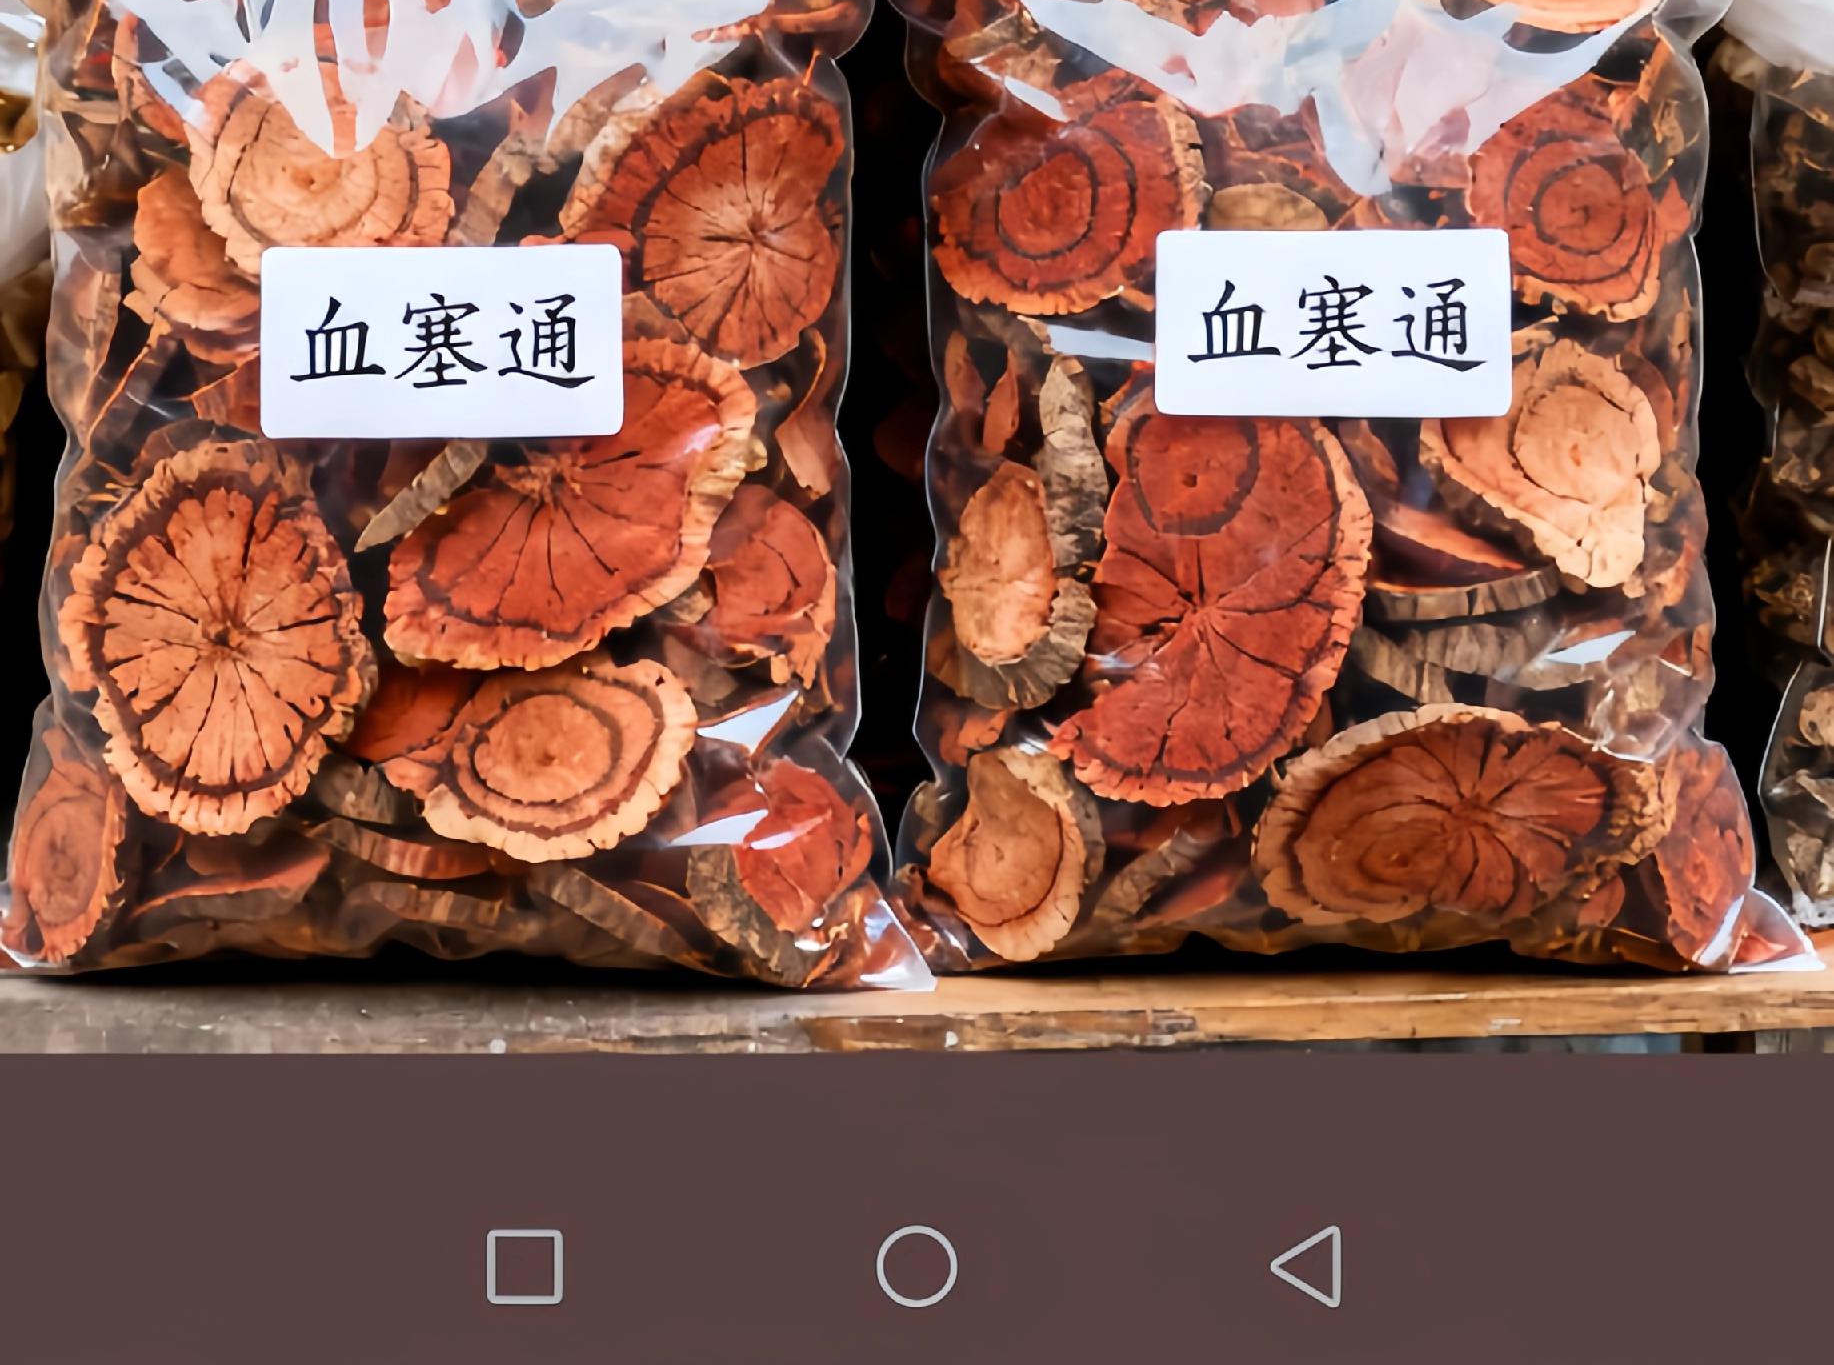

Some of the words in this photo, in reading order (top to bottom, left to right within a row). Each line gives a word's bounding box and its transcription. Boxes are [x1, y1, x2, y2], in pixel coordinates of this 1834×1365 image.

[290, 293, 596, 389] 血塞通
[1188, 275, 1486, 372] 血塞通
